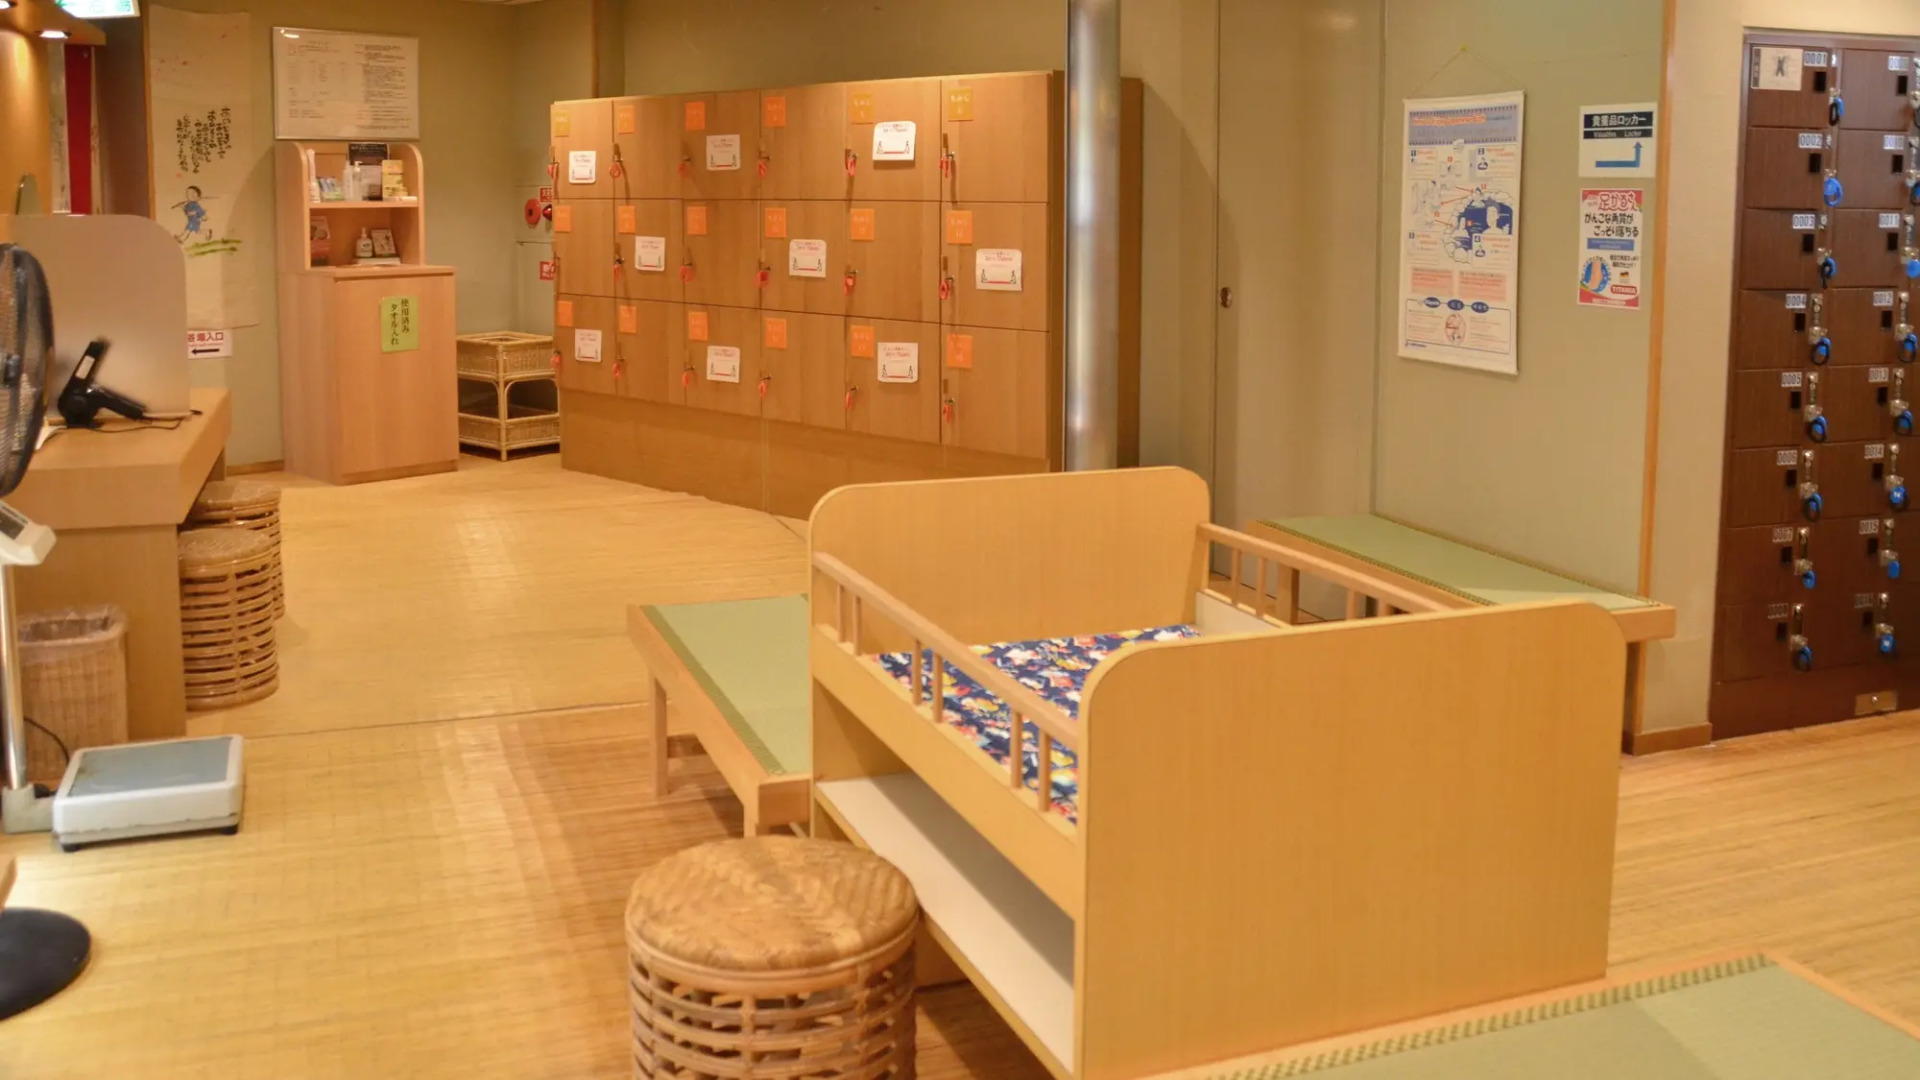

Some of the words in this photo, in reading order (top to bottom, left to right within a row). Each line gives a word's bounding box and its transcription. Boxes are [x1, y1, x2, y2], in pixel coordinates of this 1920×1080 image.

[1805, 52, 1827, 65] 0001
[1592, 114, 1647, 127] 貴重品ロッカー
[1799, 134, 1822, 147] 0002
